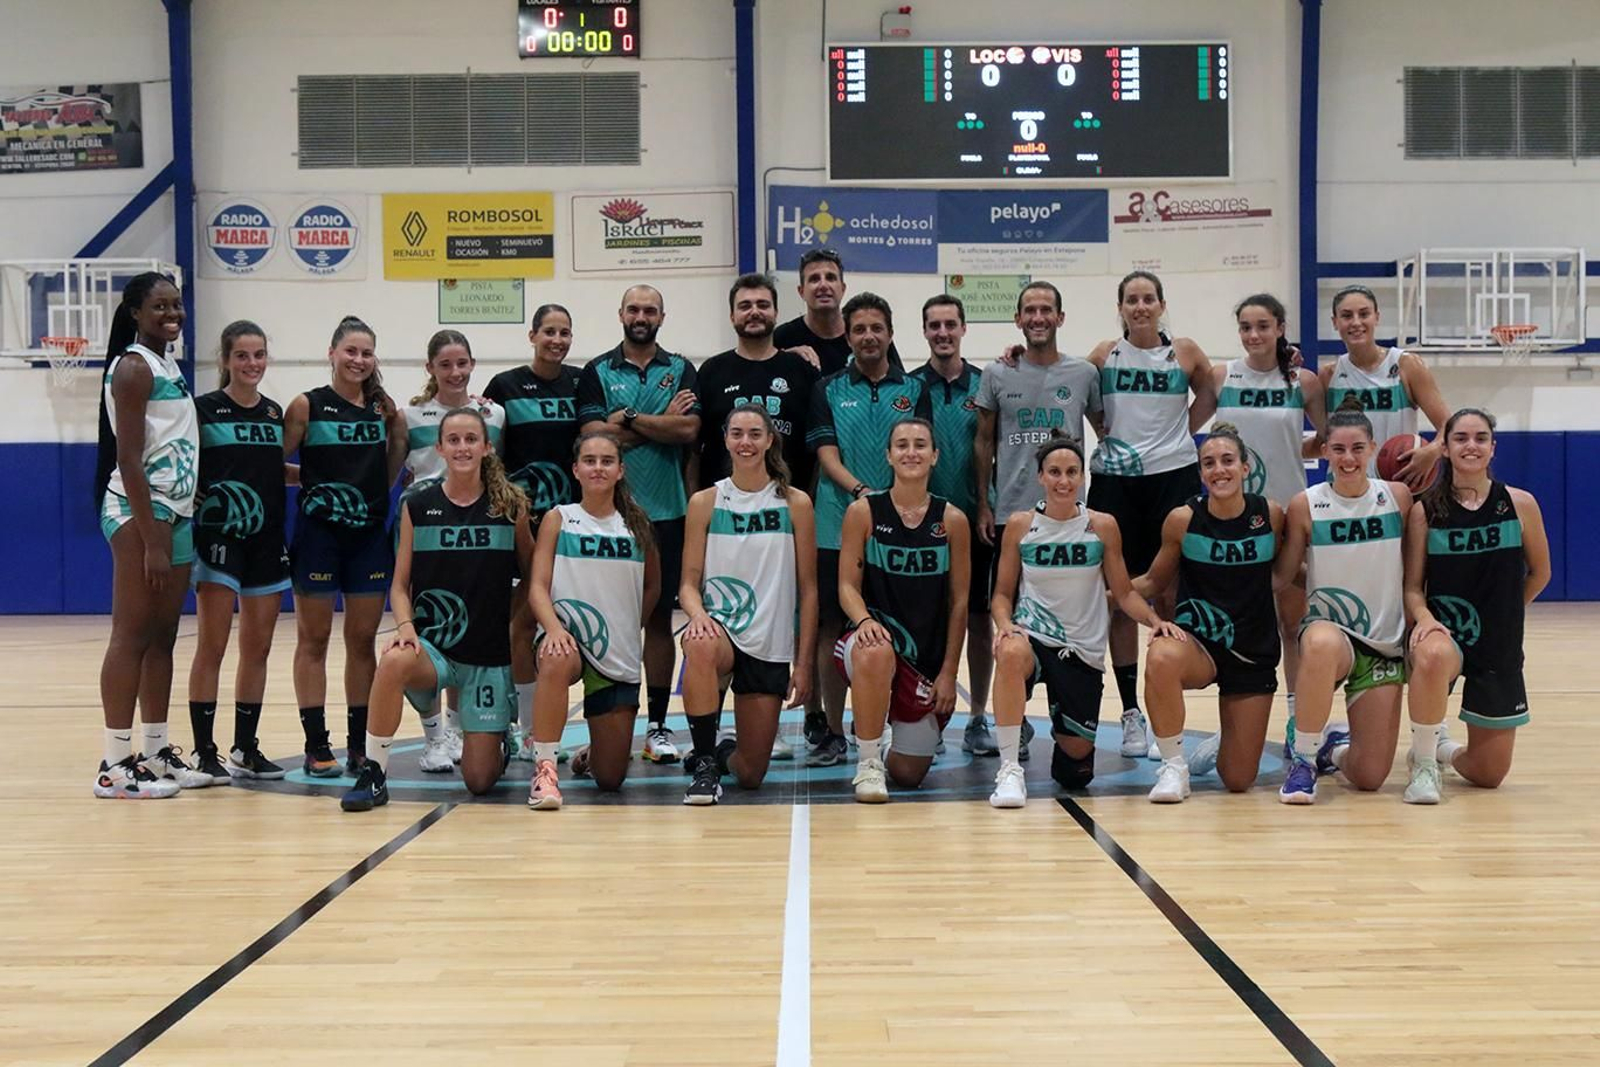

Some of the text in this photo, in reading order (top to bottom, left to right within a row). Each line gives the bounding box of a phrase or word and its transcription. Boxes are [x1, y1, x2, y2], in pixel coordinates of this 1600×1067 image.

[544, 8, 557, 28] 0
[614, 8, 627, 28] 0
[526, 35, 536, 52] 0
[548, 31, 612, 52] 00:00
[622, 34, 632, 50] 0
[970, 49, 1006, 64] LOC
[1051, 48, 1082, 63] VIS
[982, 64, 1000, 87] 0
[1057, 64, 1076, 86] 0
[1020, 120, 1037, 141] 0
[1014, 143, 1046, 153] null-0
[221, 214, 263, 226] RADIO
[303, 215, 344, 226] RADIO
[447, 209, 543, 223] ROMBOSOL
[850, 212, 933, 230] achedosol
[991, 203, 1050, 224] pelayo
[216, 229, 269, 245] MARCA
[298, 230, 350, 246] MARCA
[500, 238, 543, 247] SEMINUEVO
[606, 238, 651, 248] JARDINES
[662, 236, 702, 246] PISCINAS
[848, 236, 932, 246] MONTES TORRES
[393, 249, 436, 258] RENAULT
[455, 248, 489, 256] OCASIÓN
[470, 282, 493, 291] PISTA
[977, 280, 1000, 289] PISTA
[460, 294, 504, 302] LEONARDO
[450, 306, 480, 315] TORRES
[1116, 370, 1168, 392] CAB
[1240, 390, 1284, 408] CAB
[1344, 388, 1392, 410] AB
[540, 400, 578, 419] CA
[1017, 408, 1065, 428] CAB
[234, 424, 278, 443] CAB
[337, 424, 380, 442] CAB
[1009, 432, 1052, 446] ESTEP
[732, 511, 781, 533] CAB
[1330, 517, 1384, 544] CAB
[440, 528, 491, 548] CAB
[1448, 526, 1500, 552] CAB
[210, 544, 227, 564] 11
[580, 537, 632, 558] CAB
[1035, 543, 1087, 566] CAB
[1210, 540, 1257, 563] CAB
[887, 549, 938, 574] CAB
[476, 685, 494, 708] 13
